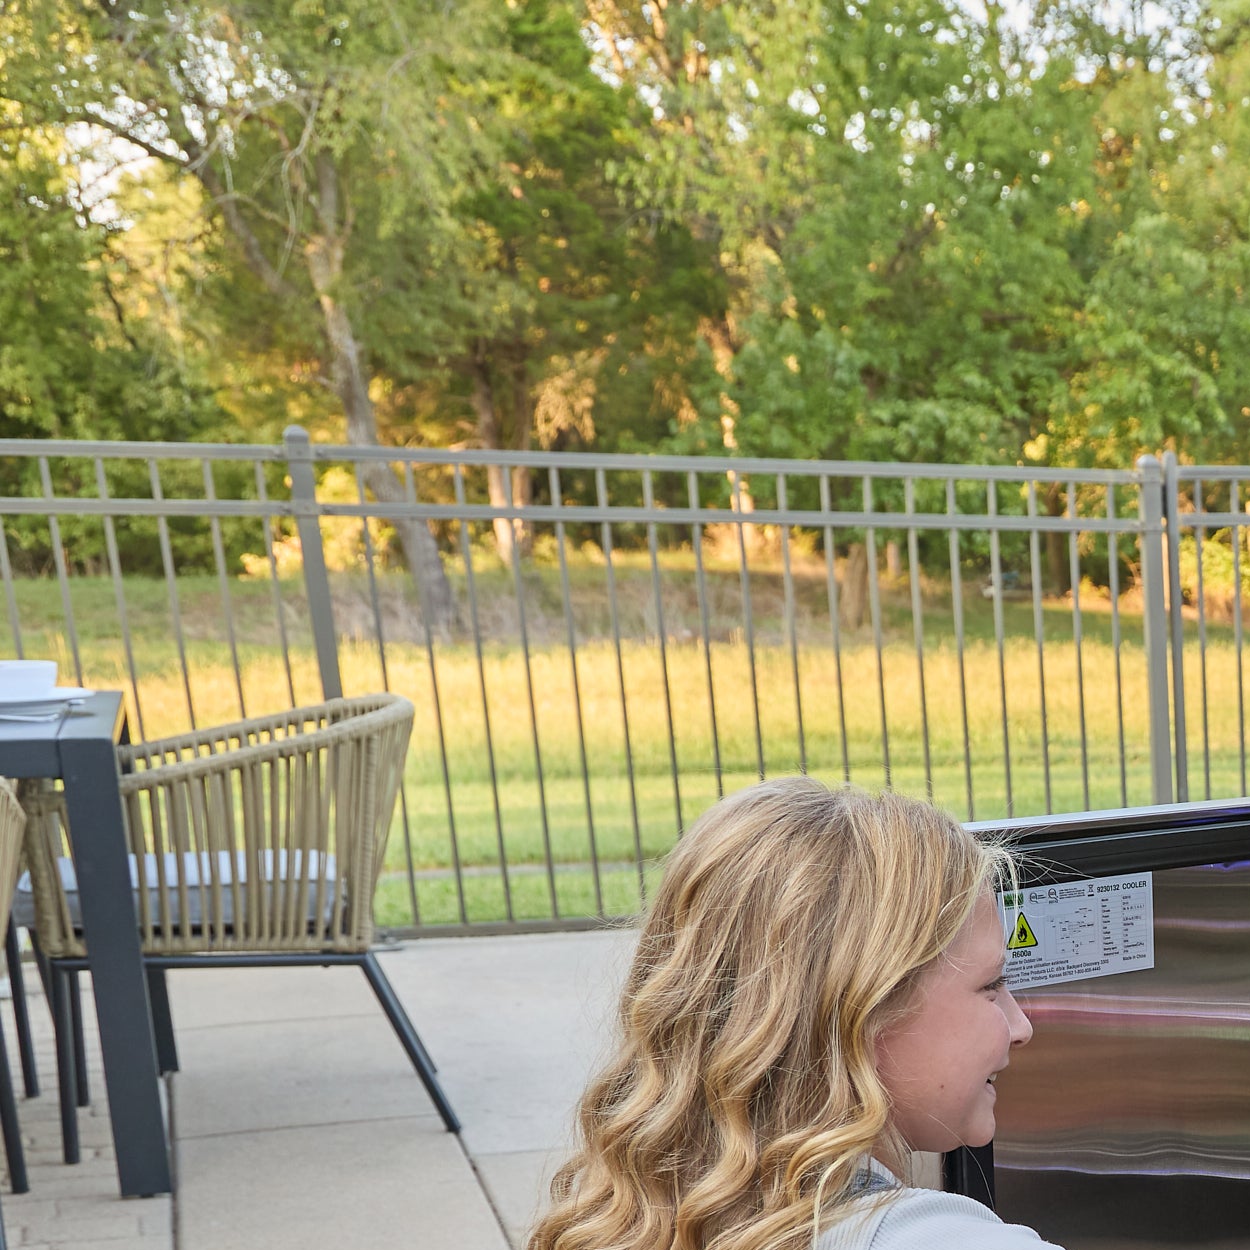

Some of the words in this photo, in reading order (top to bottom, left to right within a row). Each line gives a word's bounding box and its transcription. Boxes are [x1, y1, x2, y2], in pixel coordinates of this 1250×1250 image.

[1096, 884, 1120, 893] 9230132
[1122, 880, 1147, 890] COOLER
[1012, 949, 1032, 959] R600a
